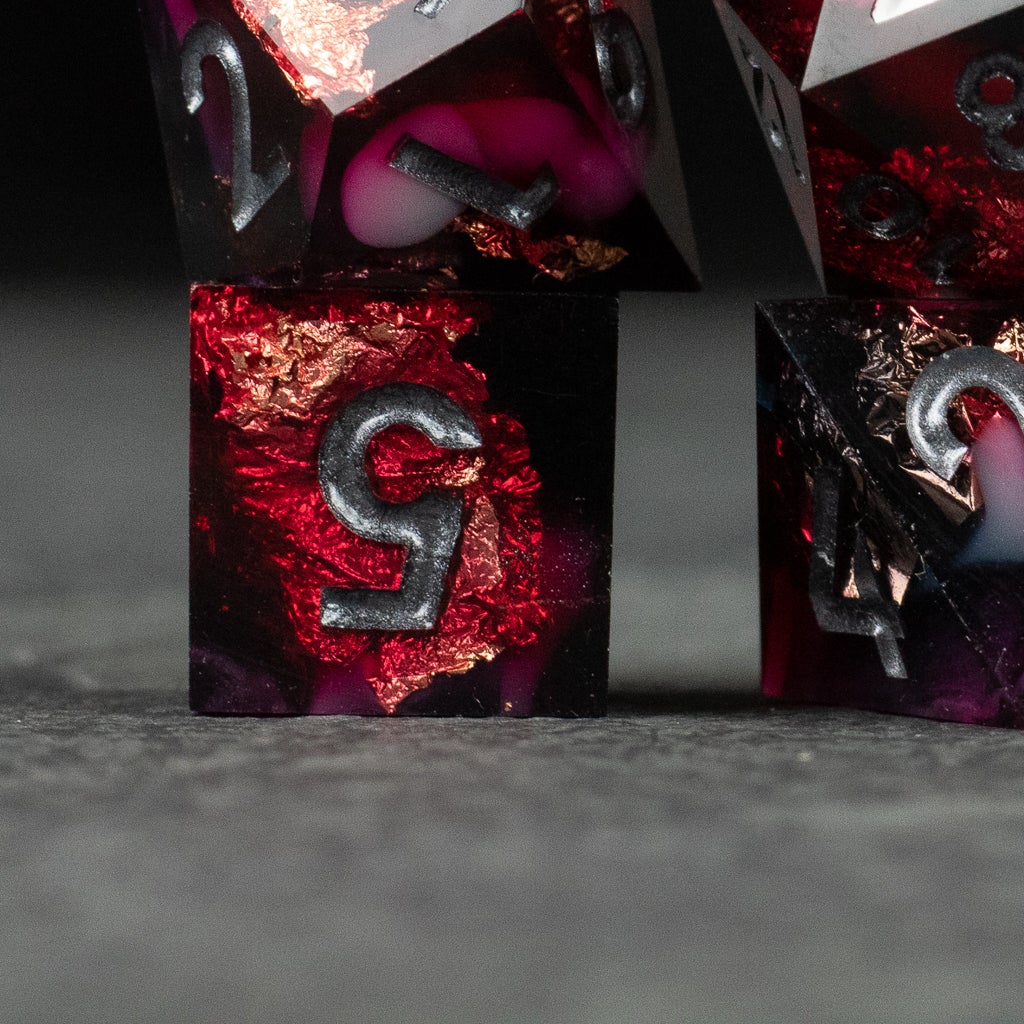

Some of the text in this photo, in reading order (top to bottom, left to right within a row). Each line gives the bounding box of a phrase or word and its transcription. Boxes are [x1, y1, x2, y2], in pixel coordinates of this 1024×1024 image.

[180, 19, 290, 233] 2
[317, 381, 484, 631] 5
[808, 464, 909, 680] 4
